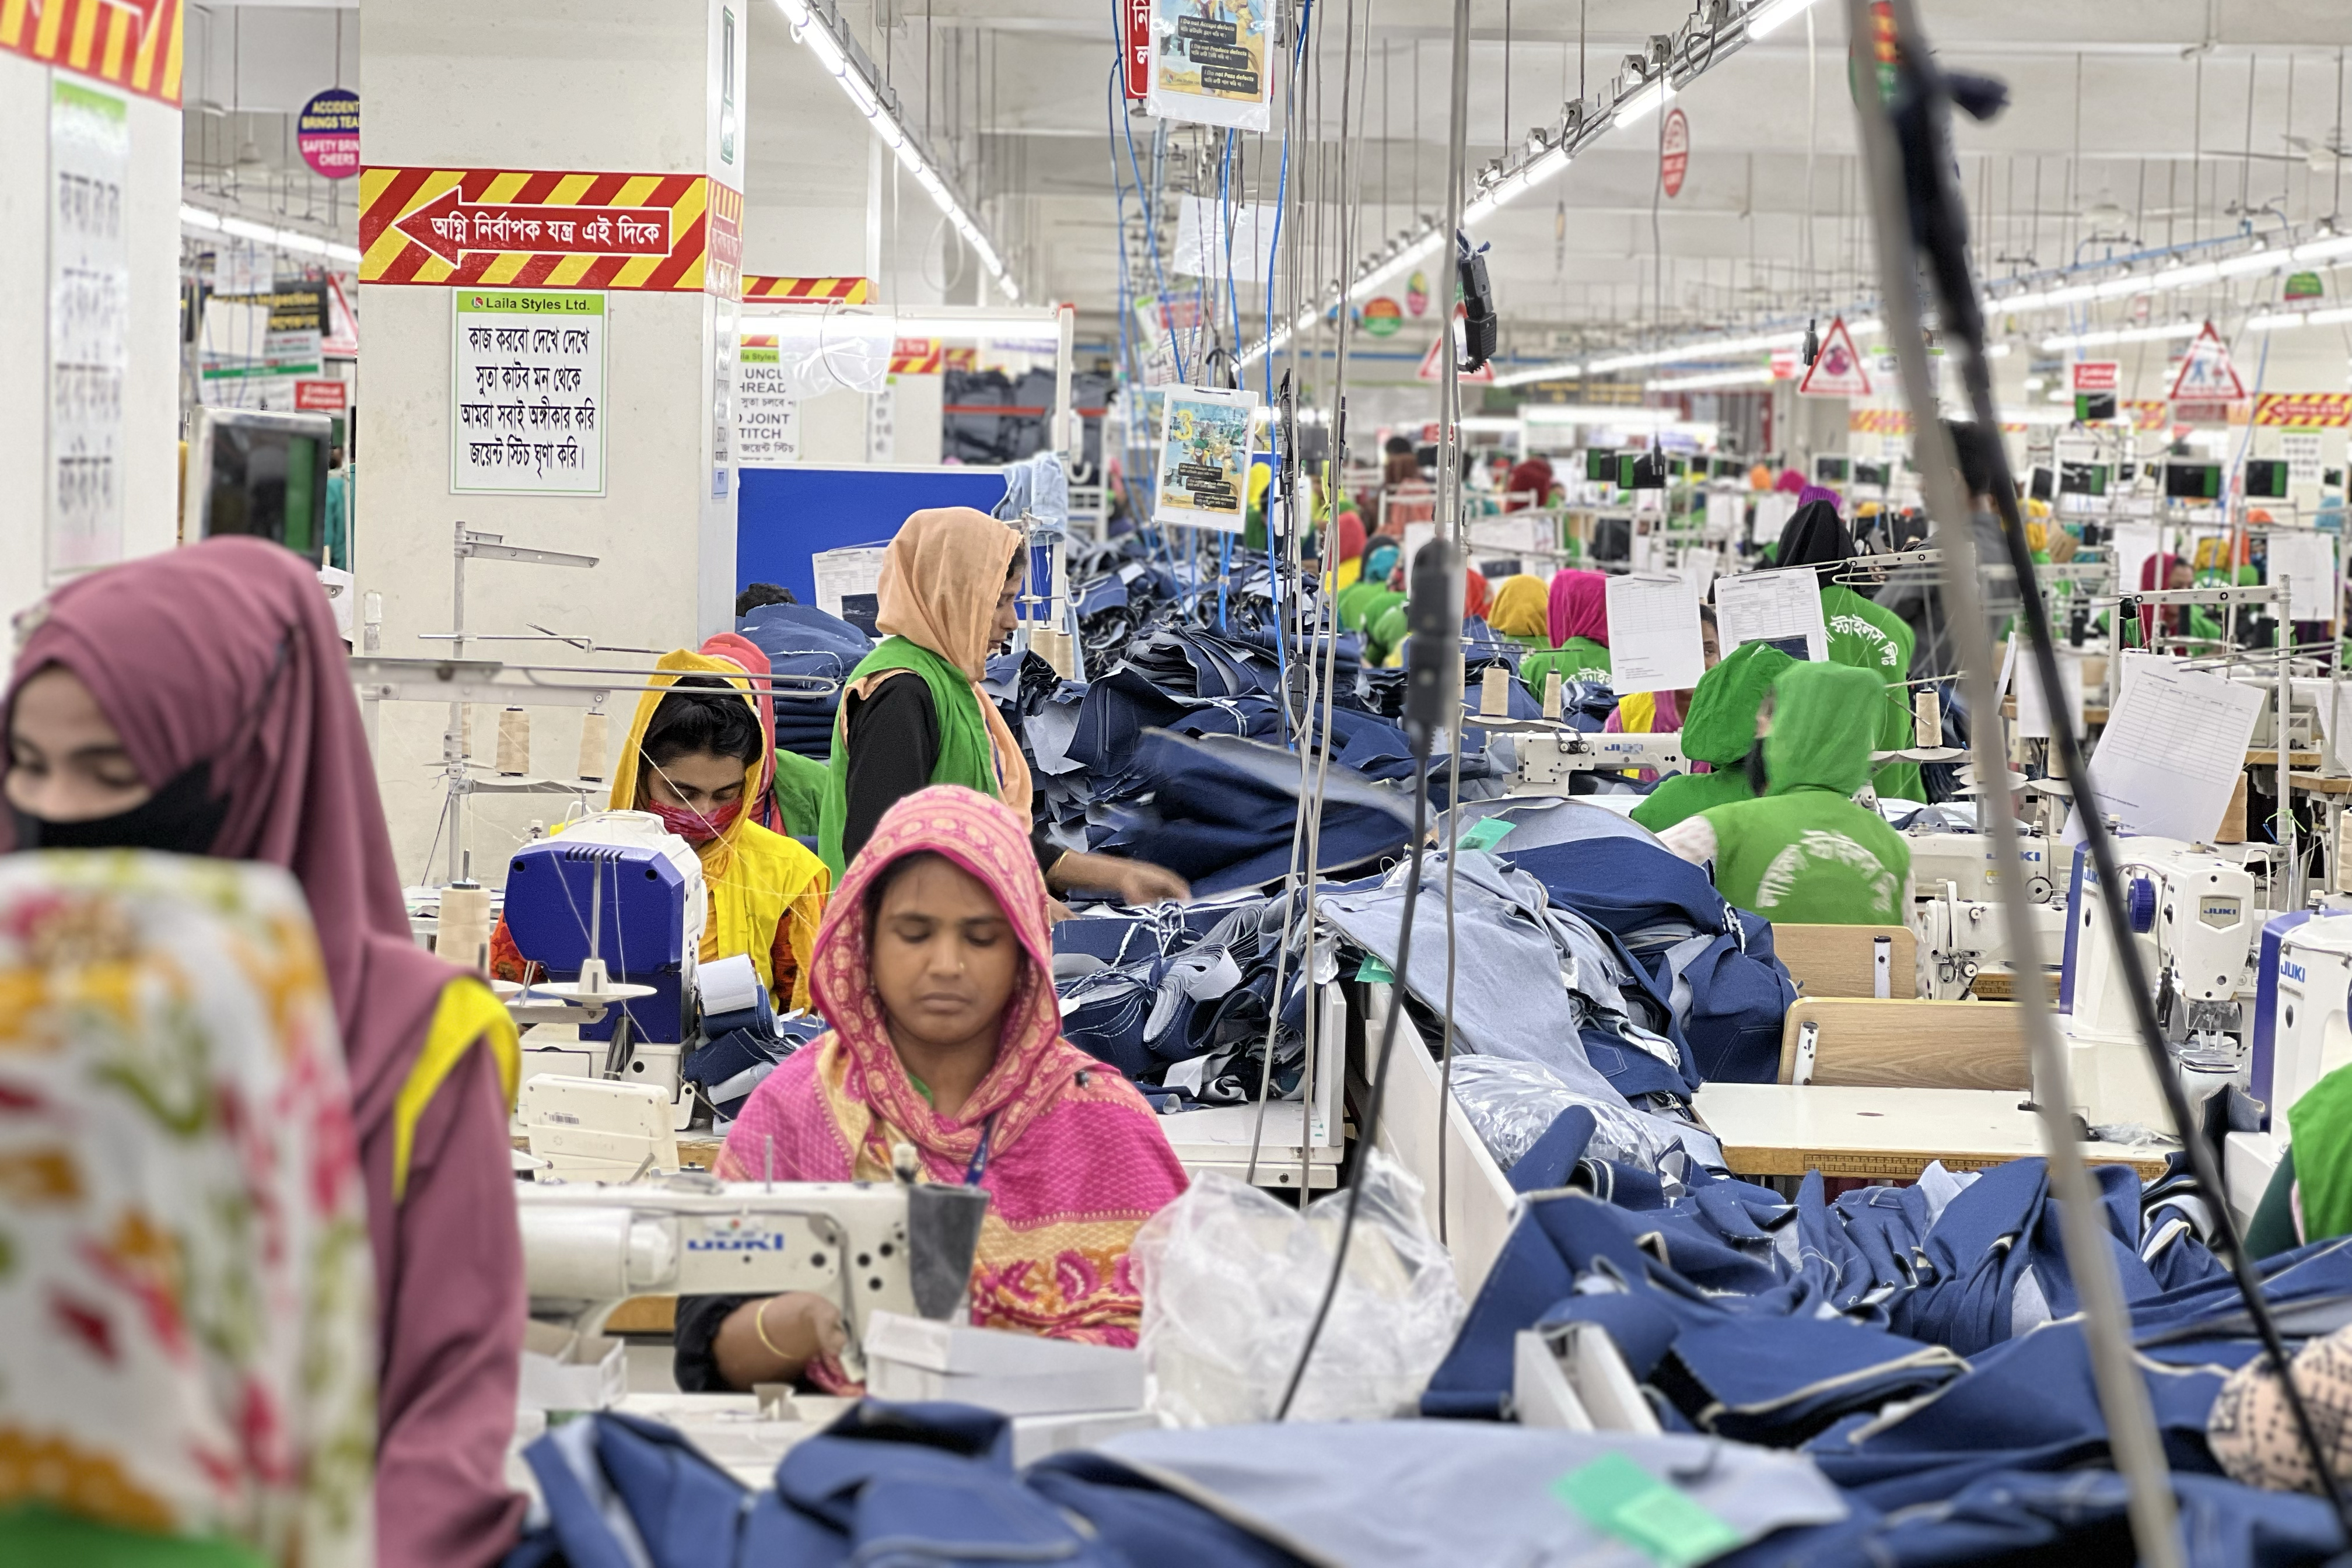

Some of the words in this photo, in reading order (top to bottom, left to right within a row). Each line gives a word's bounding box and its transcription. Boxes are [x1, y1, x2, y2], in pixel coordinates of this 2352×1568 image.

[1236, 74, 1254, 82] defects
[302, 116, 338, 129] BRINGS
[340, 116, 359, 128] TEA
[302, 139, 337, 152] SAFETY
[338, 139, 359, 152] BRIN
[318, 152, 355, 166] CHEERS
[430, 211, 469, 244] অগ্নি
[473, 211, 541, 242] নির্বাপক
[546, 220, 576, 243] যন্ত্র
[582, 215, 612, 246] এই
[616, 215, 661, 244] দিকে
[486, 298, 517, 309] Laila
[522, 298, 561, 312] Styles
[566, 299, 590, 311] Ltd.
[468, 324, 493, 353] কাজ
[495, 326, 530, 354] করবো
[533, 326, 560, 354] দেখে
[563, 327, 590, 355] দেখে
[752, 353, 776, 362] Styles
[475, 363, 498, 397] সুতা
[501, 358, 530, 392] কাটব
[533, 368, 550, 393] মন
[554, 365, 582, 393] থেকে
[740, 382, 786, 393] HREAD
[460, 401, 494, 430] আমরা
[496, 396, 526, 433] সবাই
[528, 396, 572, 430] অঙ্গীকার
[574, 397, 596, 430] করি
[747, 413, 790, 424] JOINT
[1174, 410, 1194, 440] 3
[738, 428, 781, 439] TITCH
[470, 433, 504, 467] জয়েন্ট
[506, 434, 531, 468] স্টিচ
[534, 441, 554, 480] ঘৃণা
[1830, 614, 1887, 645] স্টাইলস
[1986, 851, 2041, 862] JKI
[2280, 960, 2305, 984] JUKI
